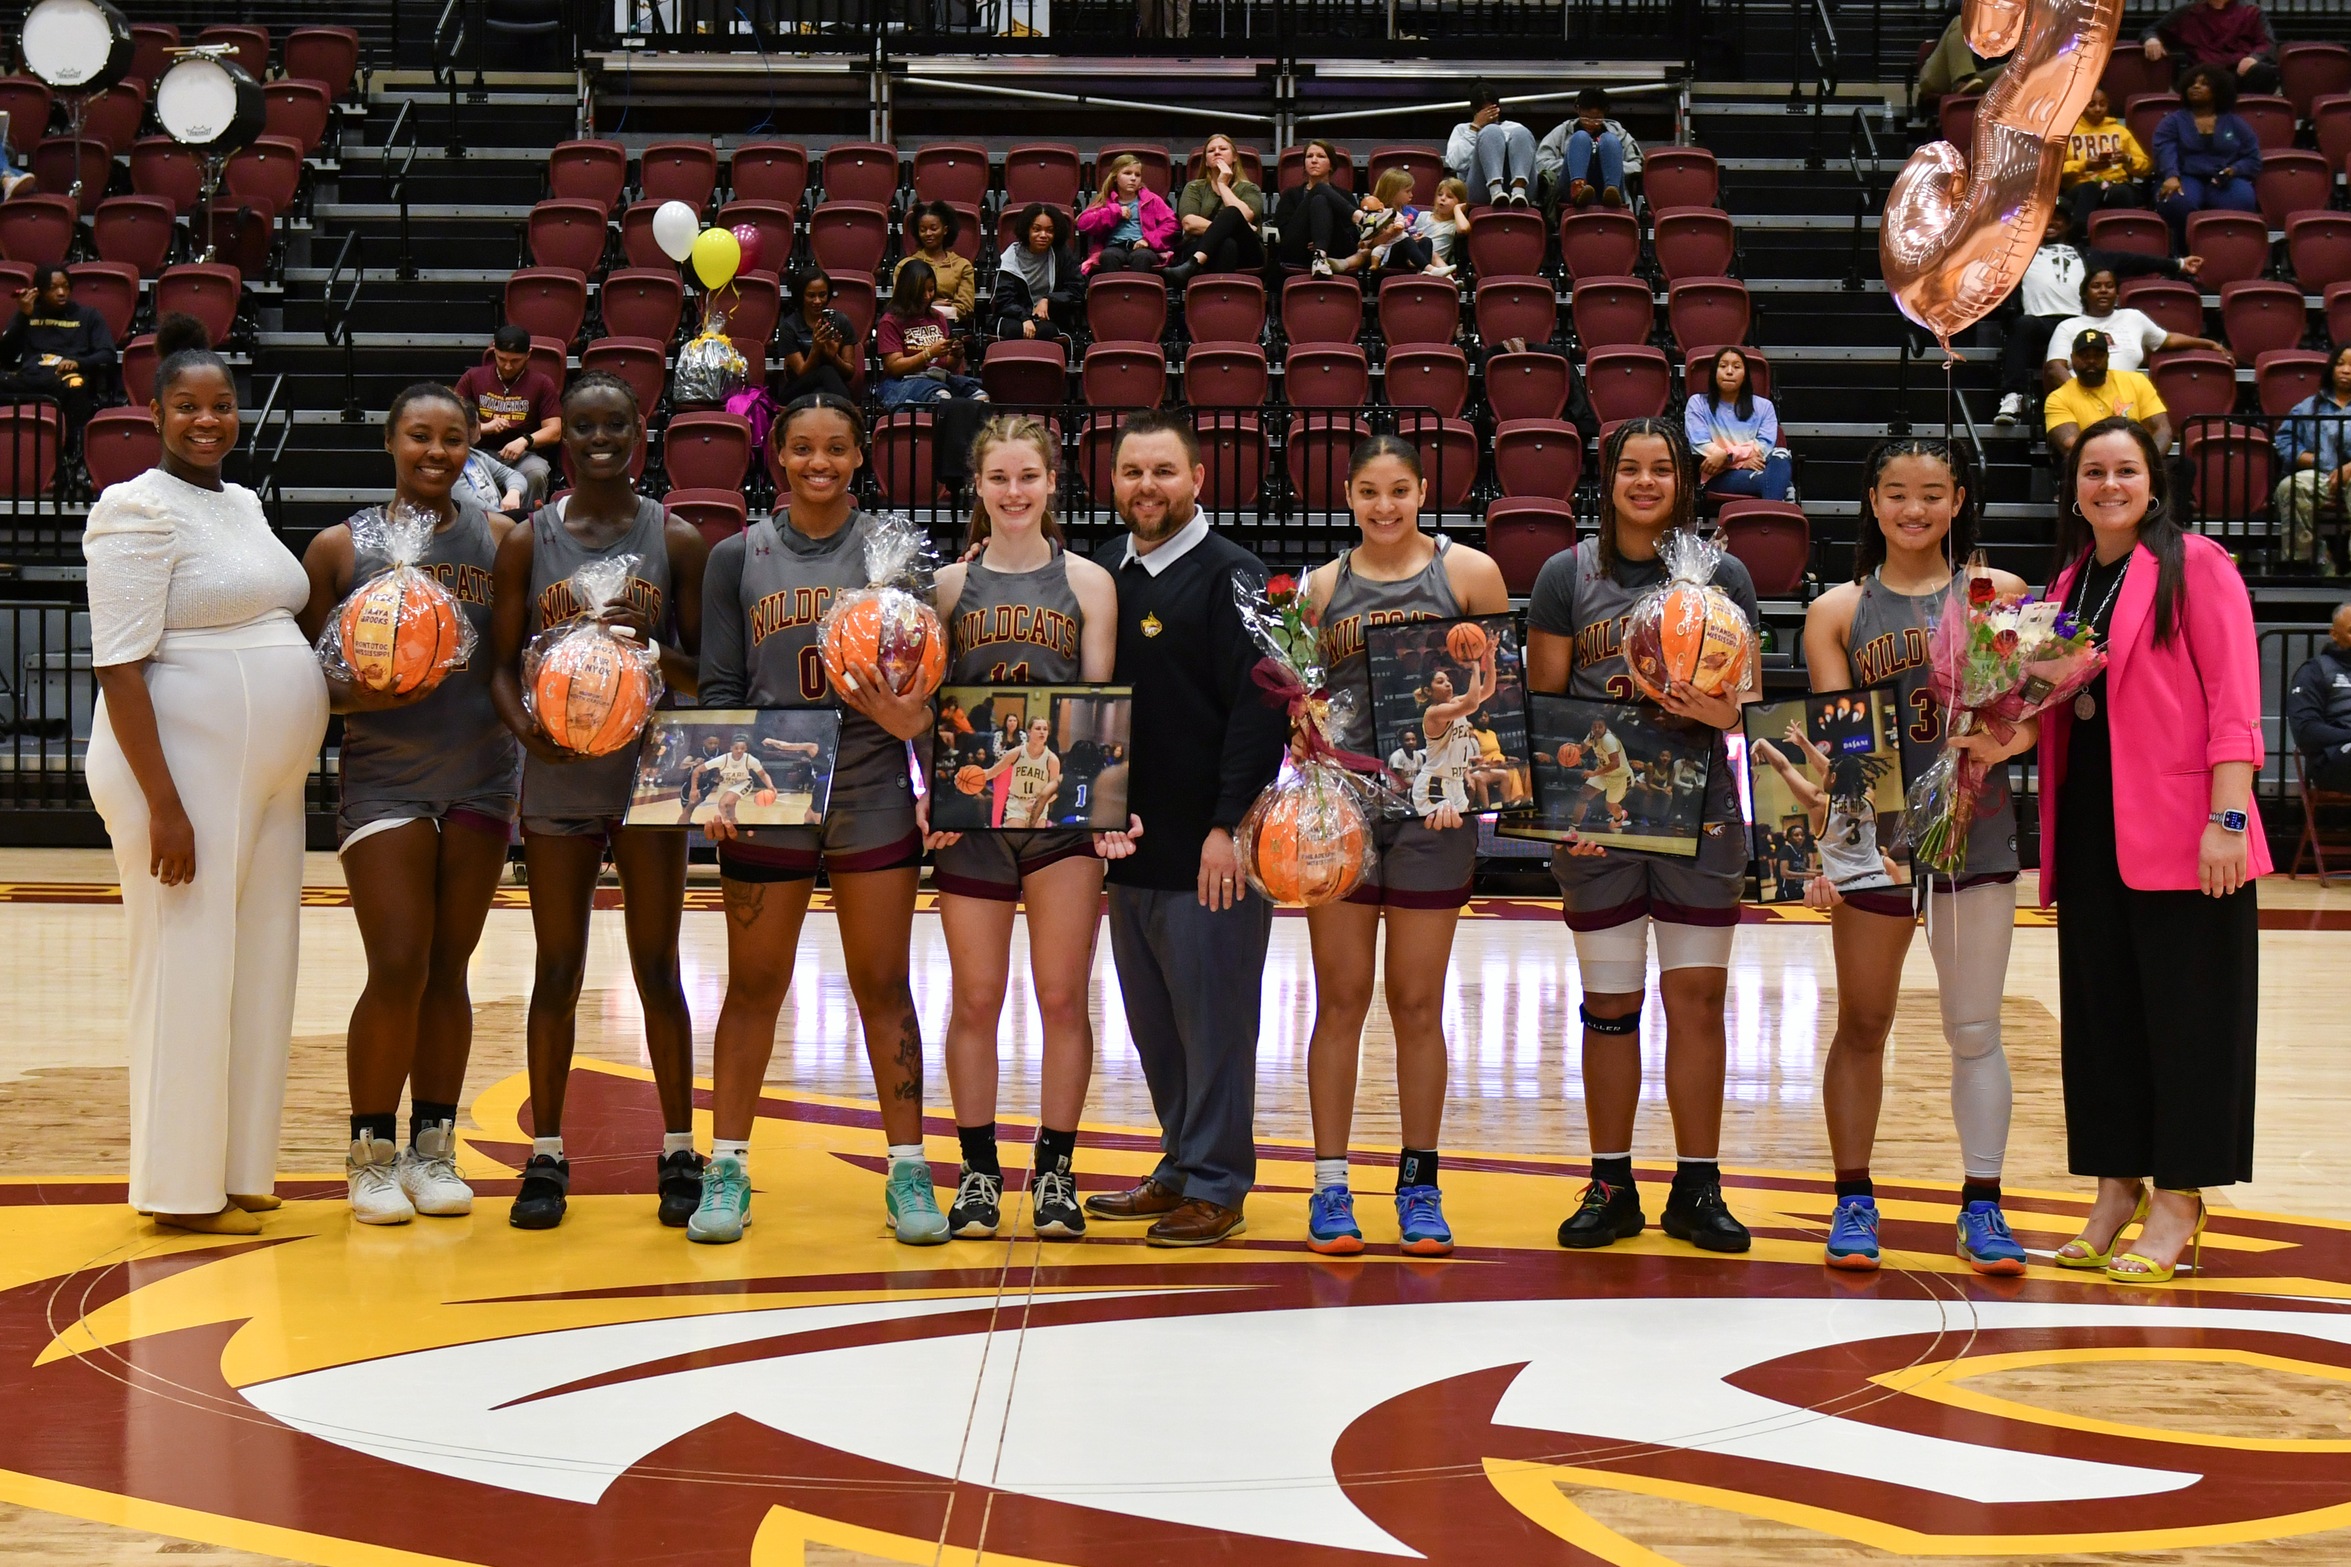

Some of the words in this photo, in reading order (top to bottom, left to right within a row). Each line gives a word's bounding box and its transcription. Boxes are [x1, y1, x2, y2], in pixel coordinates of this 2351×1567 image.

[2071, 133, 2120, 160] PRCC
[2086, 332, 2096, 343] P
[480, 395, 530, 412] WILDCATS
[955, 604, 1077, 658] WILDCATS
[1909, 688, 1940, 743] 3
[1843, 739, 1869, 750] DASANI
[1015, 766, 1045, 782] PEARL
[1023, 781, 1034, 795] 11
[1075, 784, 1088, 809] 1
[1845, 818, 1861, 846] 3
